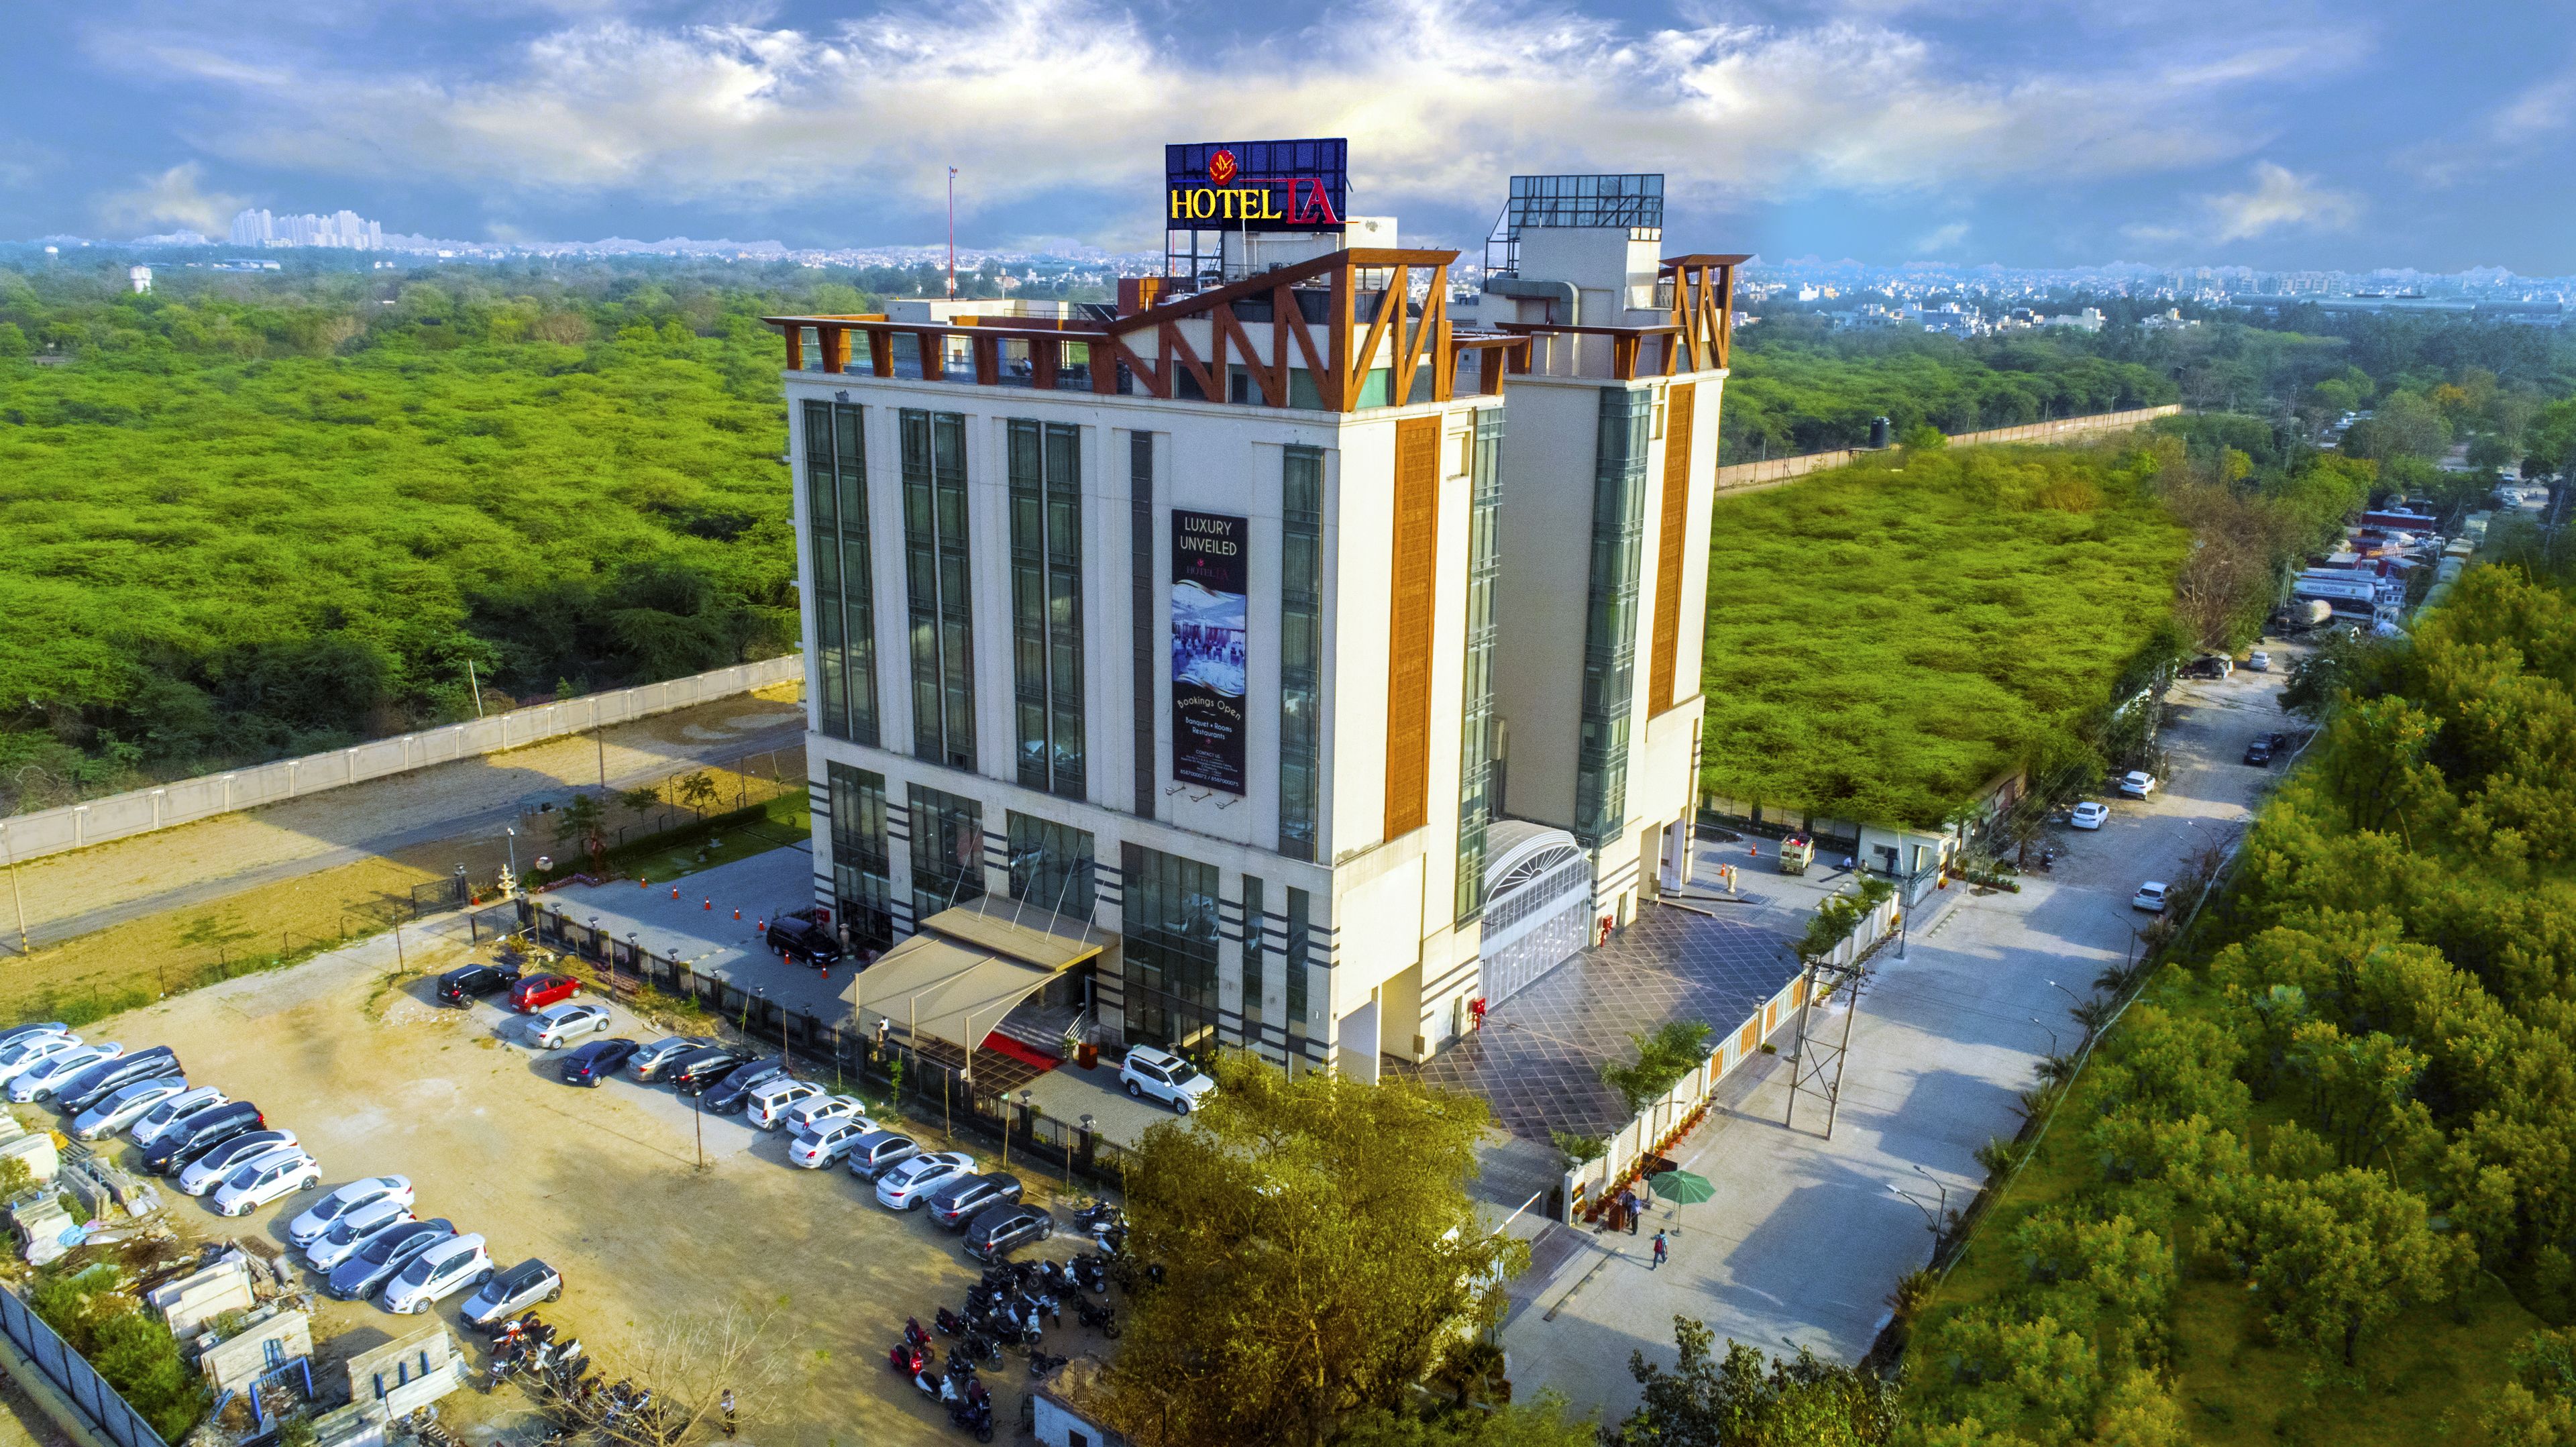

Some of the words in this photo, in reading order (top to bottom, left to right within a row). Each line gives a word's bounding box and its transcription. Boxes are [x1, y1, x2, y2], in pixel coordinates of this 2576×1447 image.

[1171, 189, 1282, 219] HOTEL
[1185, 517, 1232, 535] LUXURY
[1180, 535, 1237, 555] UNVEILED
[1187, 566, 1215, 578] HOTEL
[1177, 696, 1214, 708] Bookings
[1217, 700, 1241, 720] Open
[1185, 716, 1209, 728] Banquet
[1214, 722, 1232, 733] Rooms
[1192, 727, 1225, 739] Restaurants
[1195, 749, 1214, 757] CONTACT
